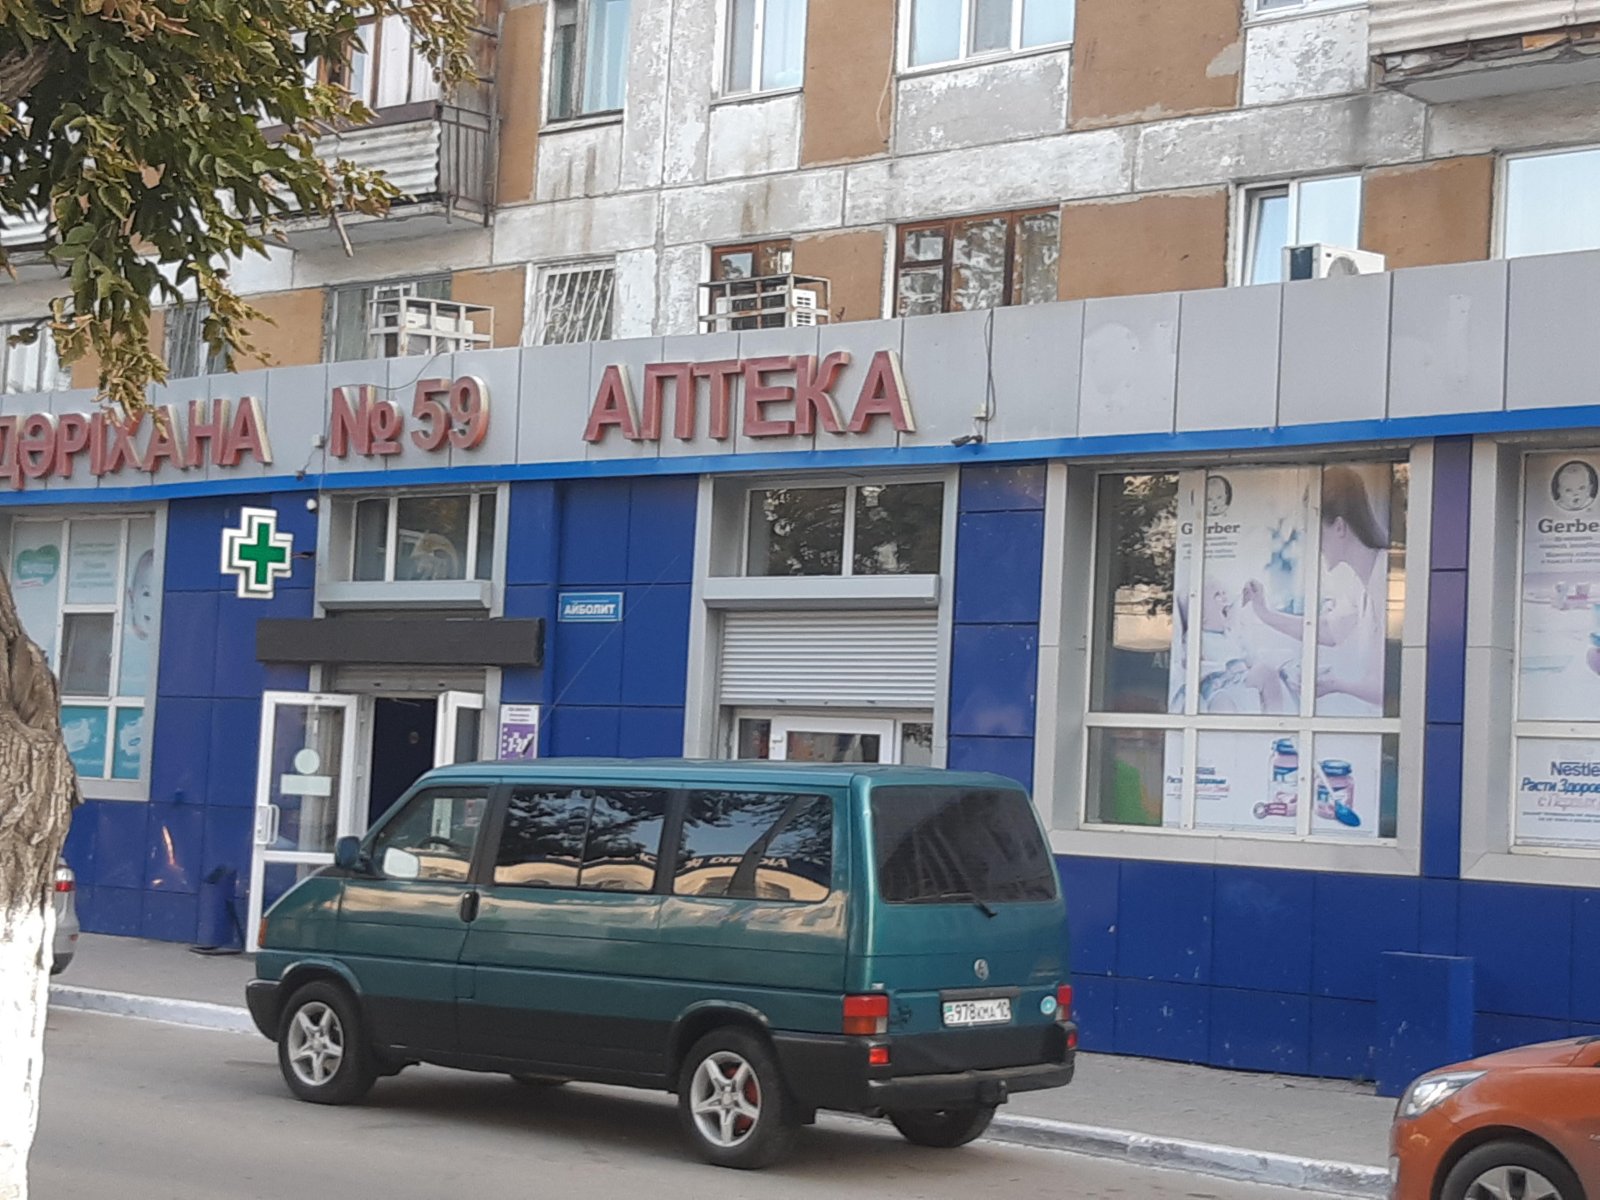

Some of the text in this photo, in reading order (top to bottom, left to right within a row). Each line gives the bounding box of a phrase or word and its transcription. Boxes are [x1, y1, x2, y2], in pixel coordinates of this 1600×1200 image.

[583, 350, 915, 441] АПТЕКА
[1181, 522, 1240, 535] Grber
[564, 602, 616, 614] АЙБОЛИТ
[1521, 777, 1557, 791] Расти
